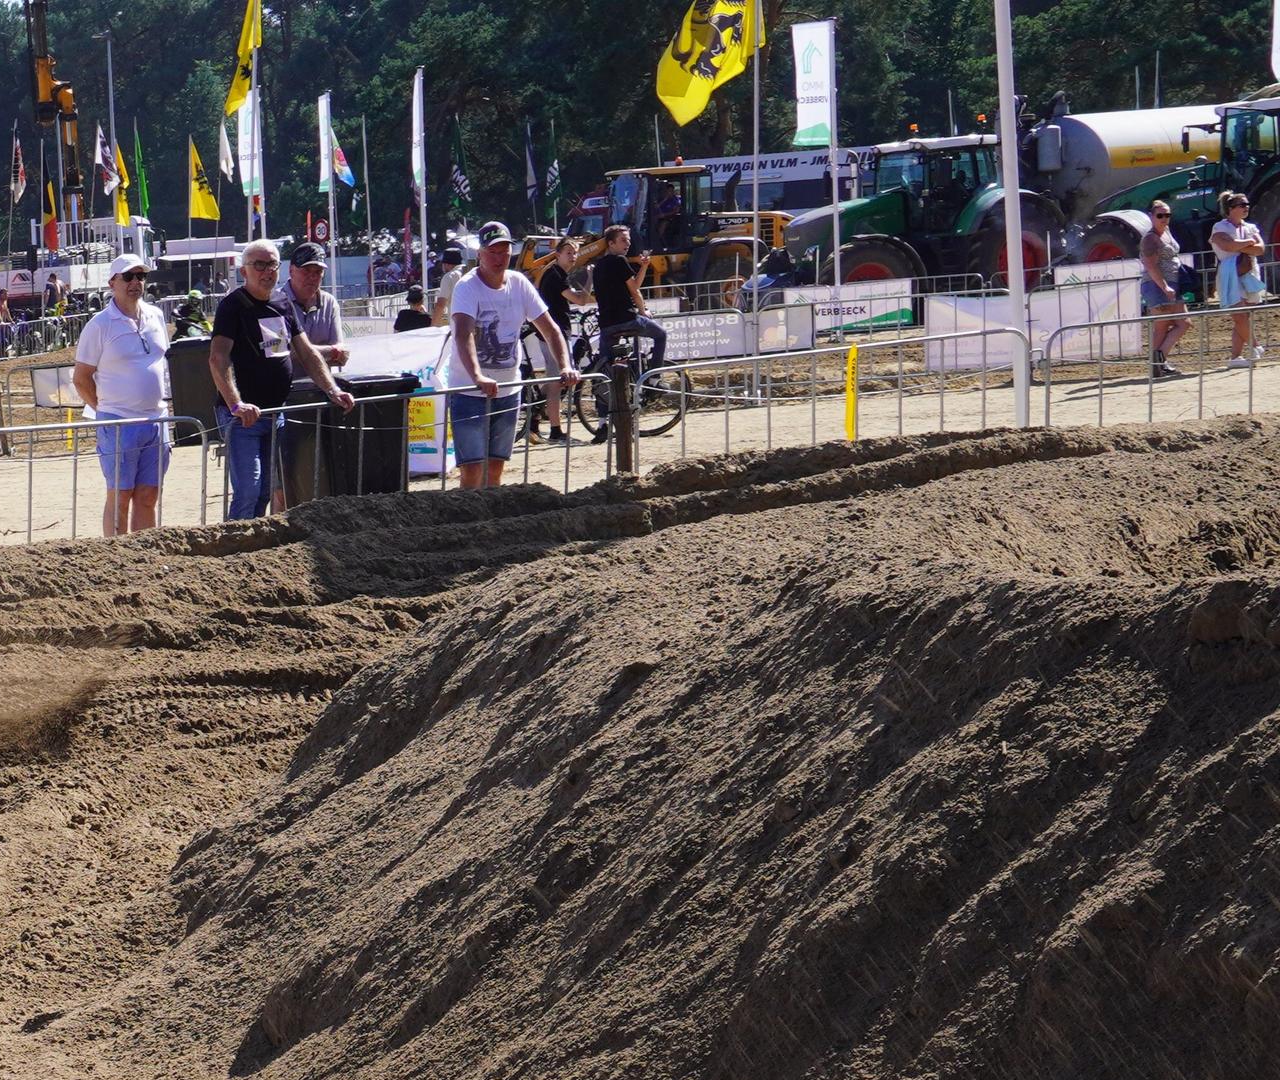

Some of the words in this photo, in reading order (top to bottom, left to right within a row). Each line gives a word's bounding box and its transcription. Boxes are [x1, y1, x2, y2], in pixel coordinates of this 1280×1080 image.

[771, 158, 798, 169] VLM
[315, 222, 327, 236] 30
[815, 305, 867, 316] VERBEECK
